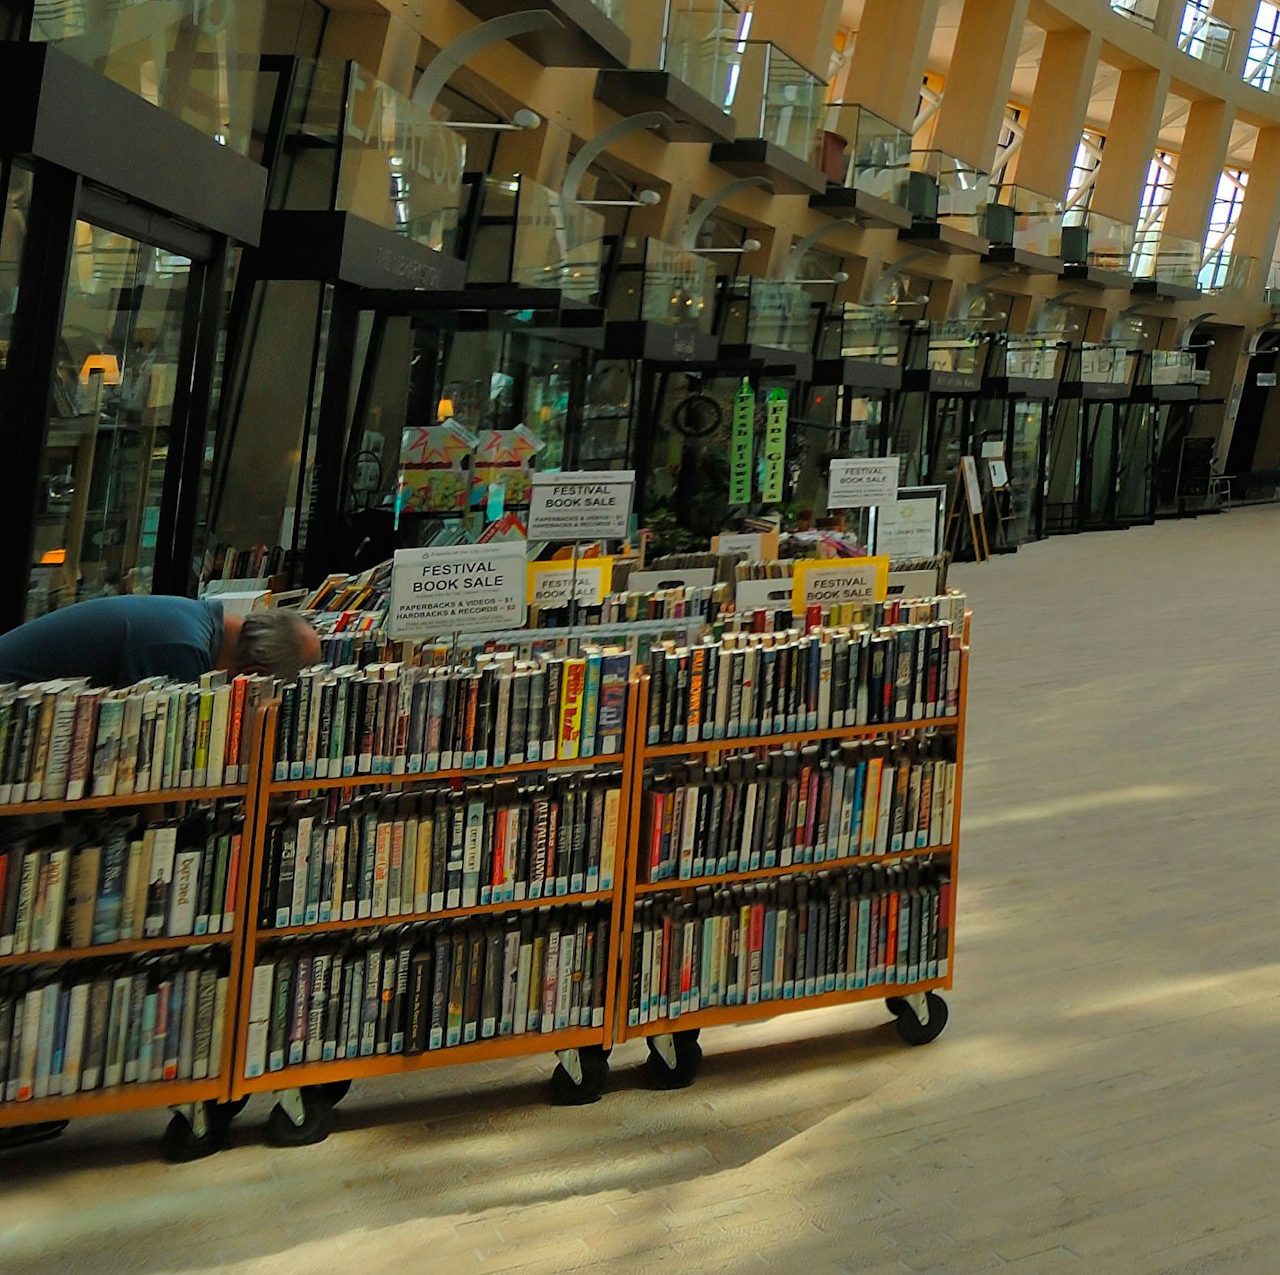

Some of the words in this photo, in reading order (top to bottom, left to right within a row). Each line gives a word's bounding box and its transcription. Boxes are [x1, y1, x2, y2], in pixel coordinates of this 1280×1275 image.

[844, 467, 884, 476] FESTIVAL
[840, 476, 863, 484] BOOK
[865, 476, 887, 484] SALE
[553, 486, 611, 496] FESTIVAL
[545, 498, 581, 508] BOOK
[584, 497, 617, 507] SALE
[422, 561, 496, 577] FESTIVAL
[412, 579, 459, 593] BOOK
[463, 575, 504, 589] SALE
[541, 578, 592, 589] FESTIAL
[813, 577, 867, 589] FESTIVAL
[535, 589, 567, 600] BOOK
[806, 590, 840, 601] BOOK
[843, 587, 873, 598] SALE
[399, 601, 456, 612] PAPERBACKS
[465, 598, 496, 607] VIDEOS
[504, 596, 514, 604] $1
[396, 610, 449, 621] HARDBACKS
[458, 606, 498, 615] RECORDS
